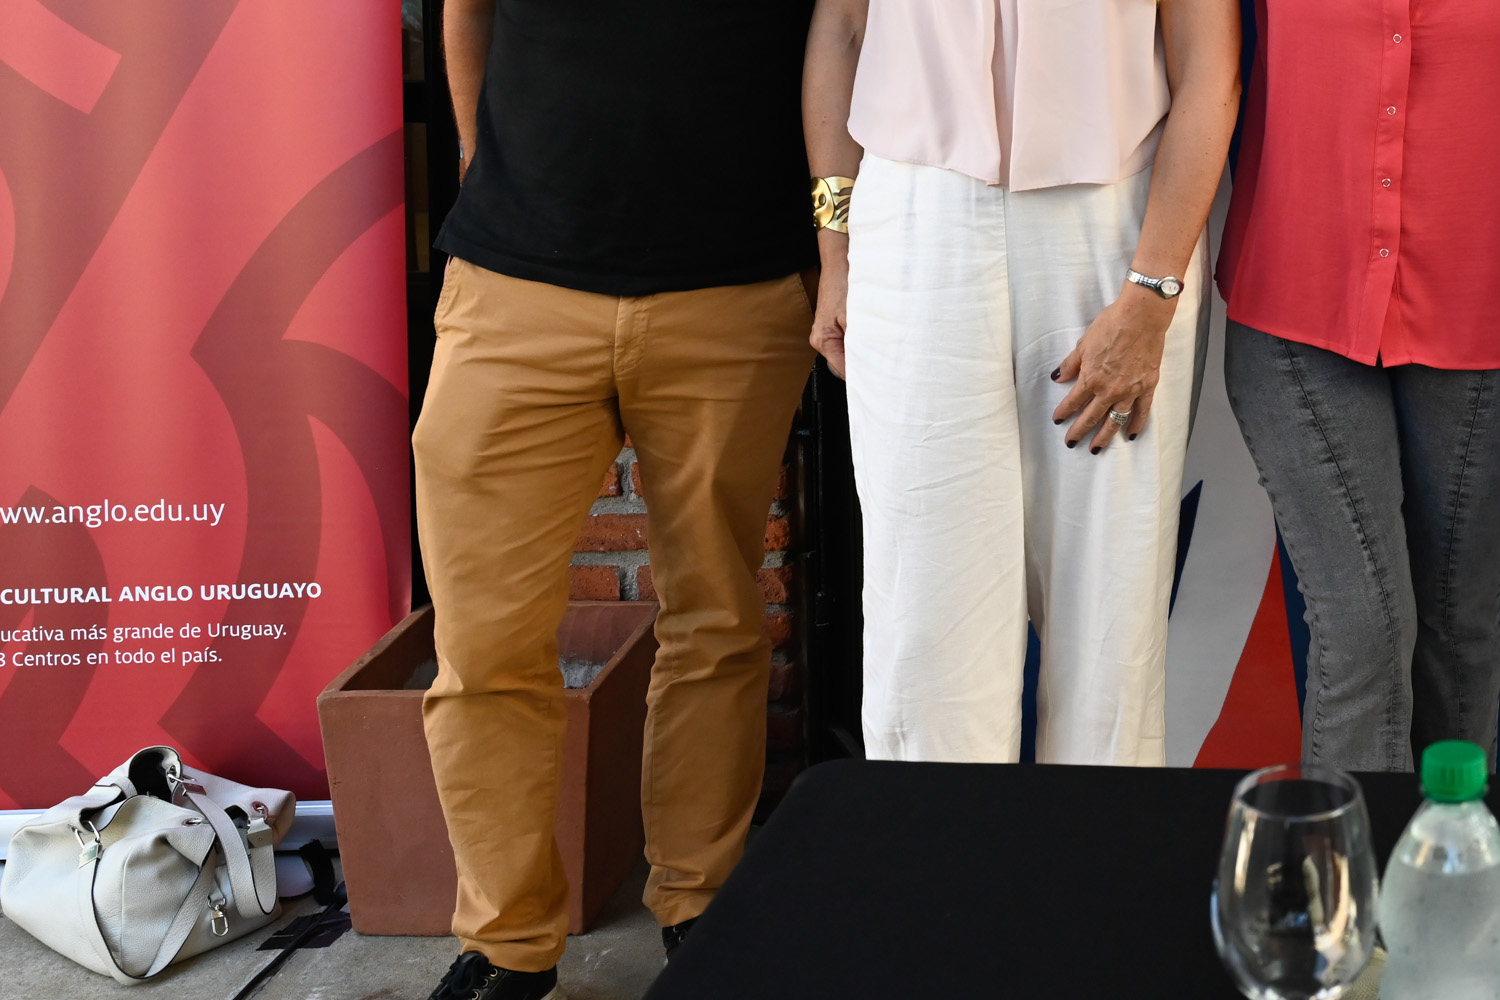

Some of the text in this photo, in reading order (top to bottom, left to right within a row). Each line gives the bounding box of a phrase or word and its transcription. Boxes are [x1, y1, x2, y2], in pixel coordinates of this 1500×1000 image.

[0, 582, 322, 604] CULTURAL ANGLO URUGUAYO
[0, 622, 287, 643] ucativa más grande de Uruguay.
[12, 650, 81, 667] Centros
[86, 651, 108, 664] en
[115, 648, 155, 664] todo
[161, 647, 175, 663] el
[182, 647, 222, 666] país.
